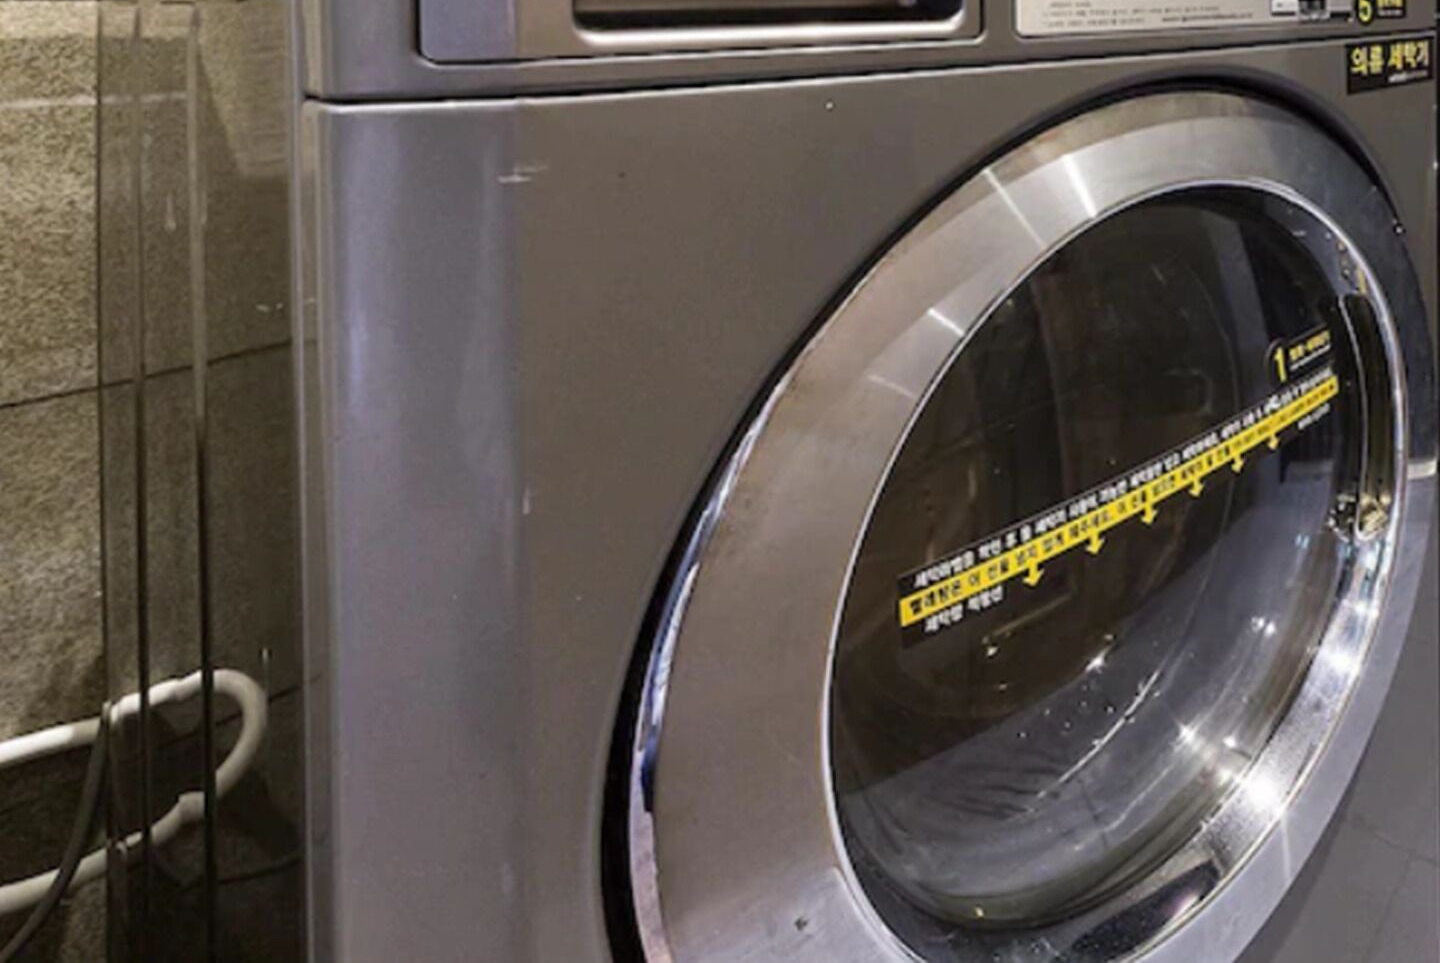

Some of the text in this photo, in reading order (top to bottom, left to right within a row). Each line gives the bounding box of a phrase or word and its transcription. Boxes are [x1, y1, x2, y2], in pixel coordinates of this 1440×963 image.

[1350, 40, 1429, 76] 의류 세탁기
[1274, 347, 1287, 383] 1
